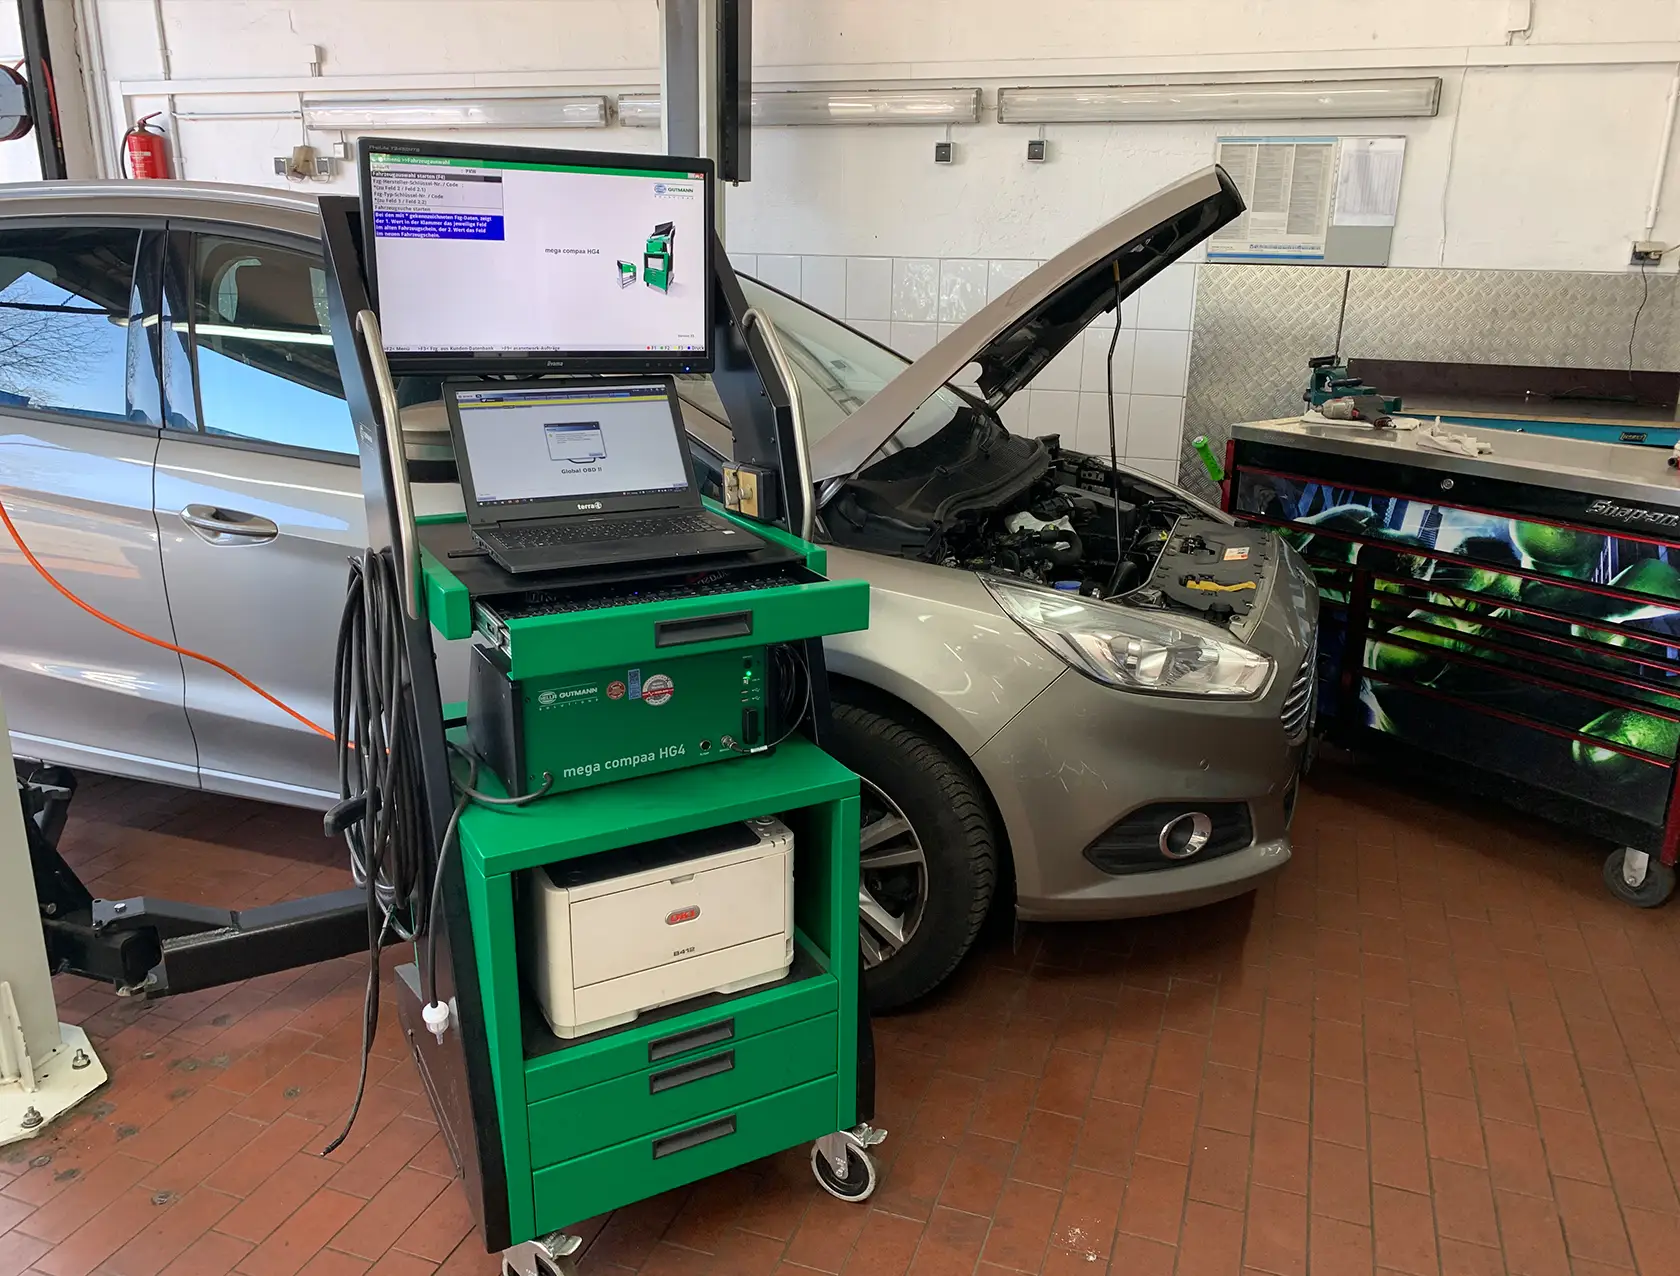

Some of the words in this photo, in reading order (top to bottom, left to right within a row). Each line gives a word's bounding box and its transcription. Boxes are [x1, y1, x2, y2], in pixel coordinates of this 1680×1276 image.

[372, 171, 416, 179] Fahrzeugauswahl
[544, 247, 562, 255] mega
[1585, 499, 1680, 527] Snap-on
[559, 687, 598, 699] GUTMANN
[563, 761, 601, 778] mega
[604, 750, 656, 771] compaa
[659, 743, 686, 759] HG4
